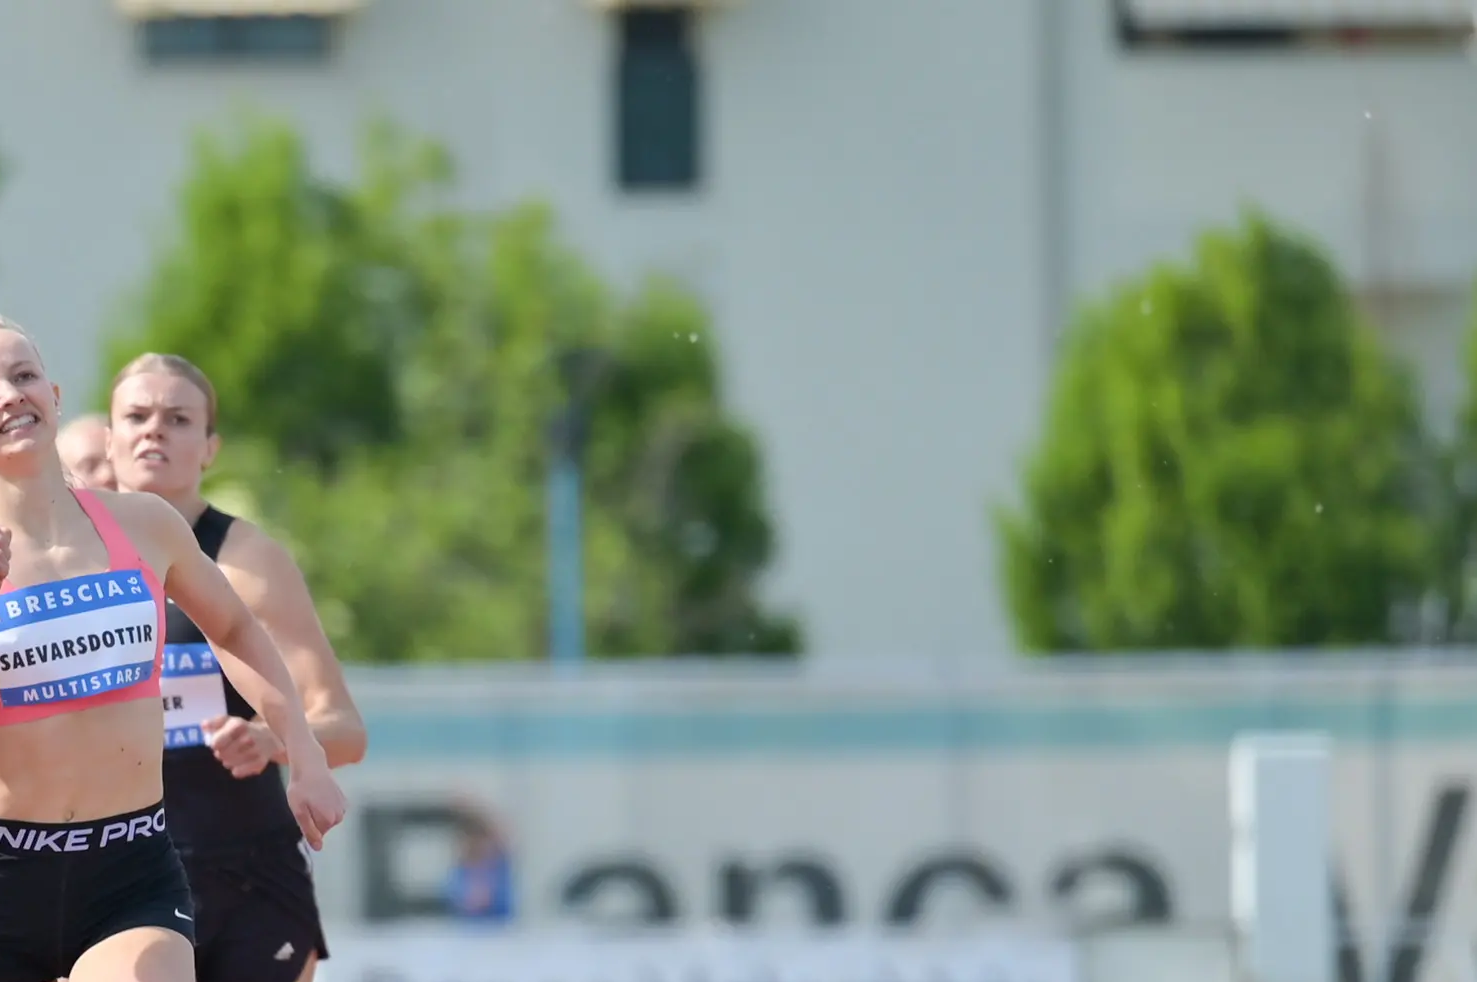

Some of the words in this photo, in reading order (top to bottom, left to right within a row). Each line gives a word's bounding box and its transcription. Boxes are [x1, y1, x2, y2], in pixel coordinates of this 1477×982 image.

[5, 579, 124, 619] BRESCIA
[127, 576, 142, 595] 26
[0, 624, 153, 672] SAEVARSDOTTIR
[23, 666, 142, 703] MULTISTARS
[99, 807, 166, 848] PRO
